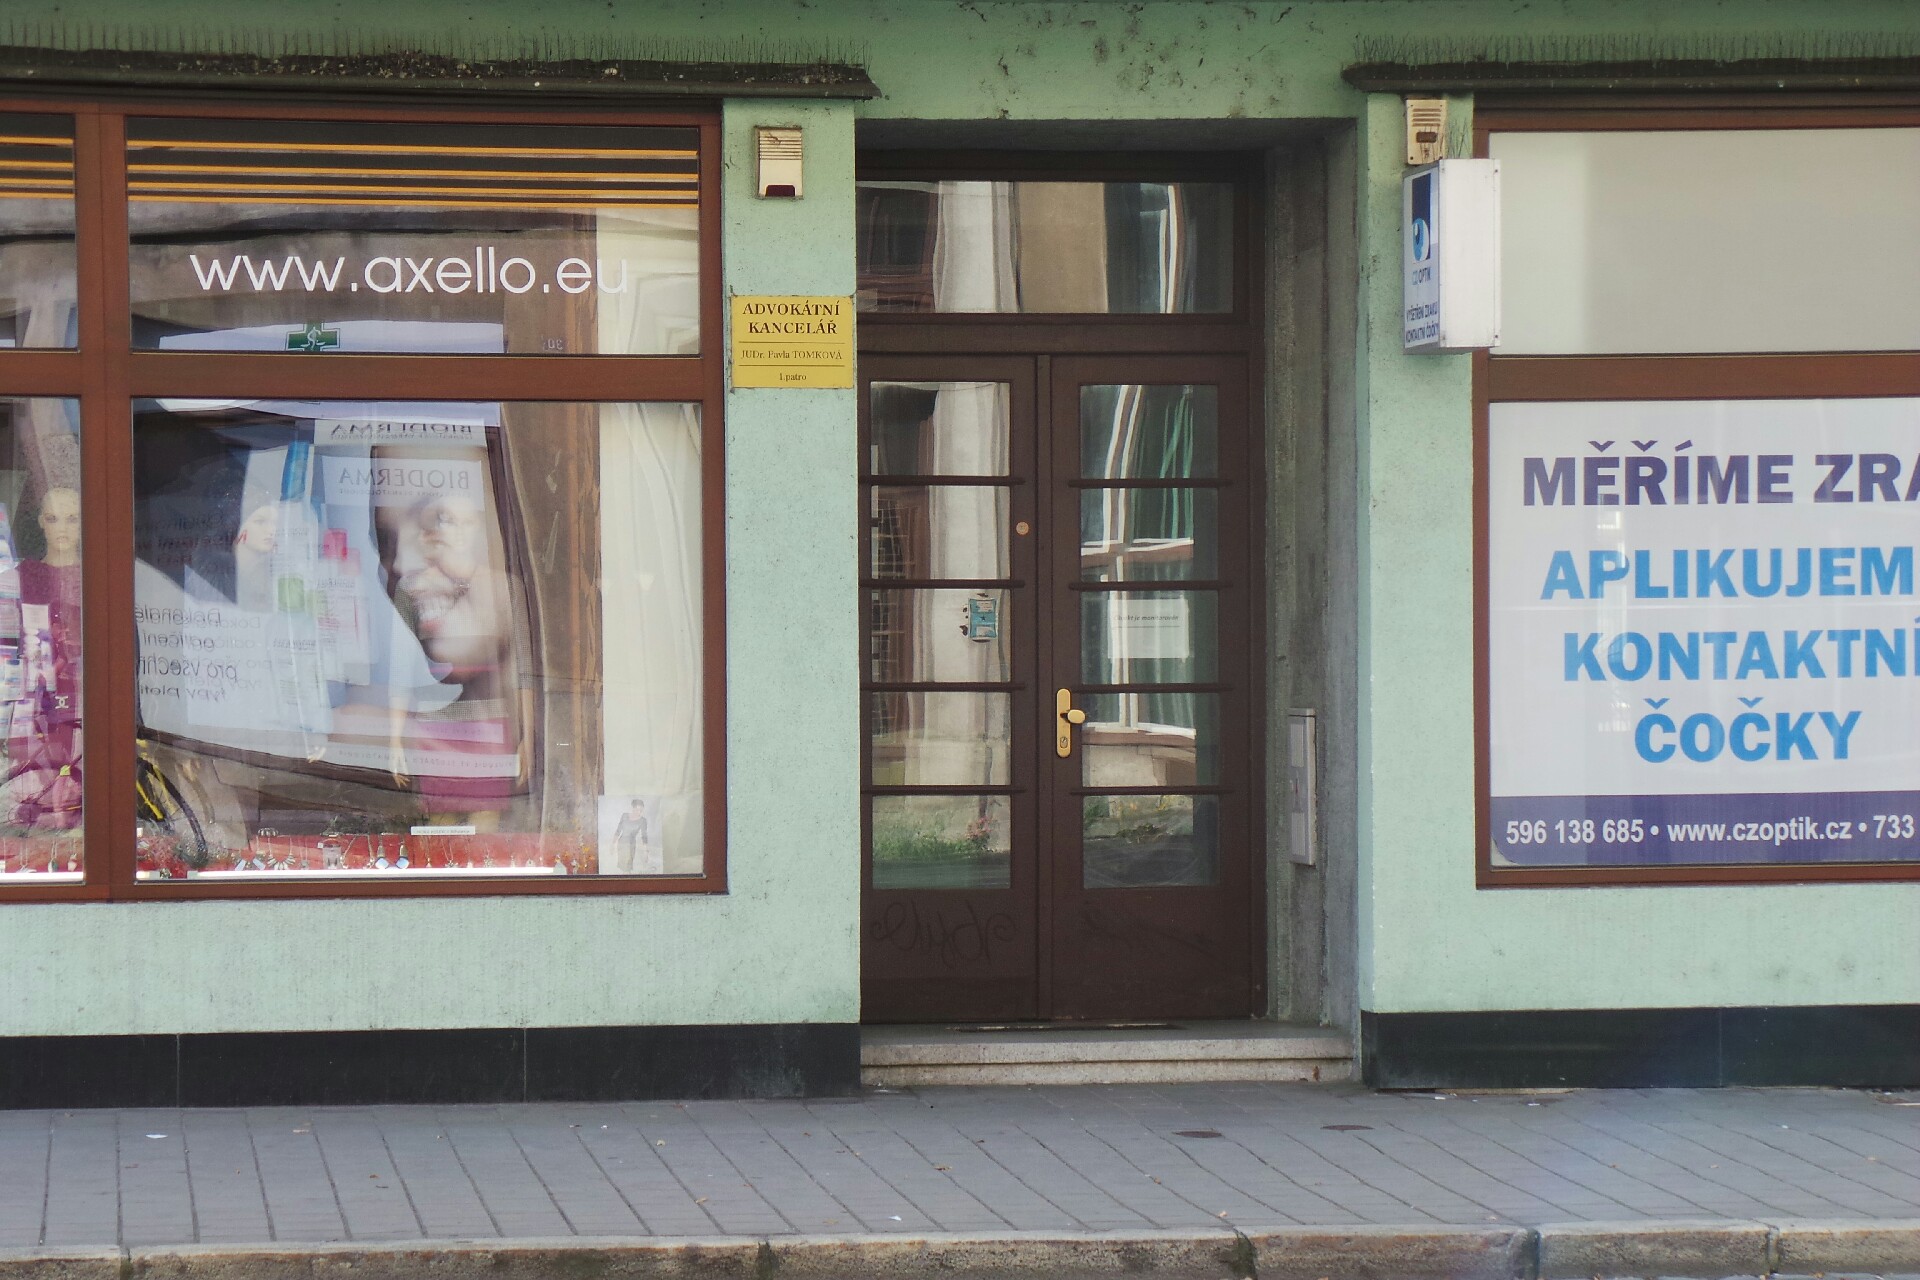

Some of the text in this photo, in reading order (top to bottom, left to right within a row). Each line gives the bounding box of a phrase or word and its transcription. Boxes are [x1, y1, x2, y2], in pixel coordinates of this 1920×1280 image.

[190, 246, 628, 295] www.axello.eu
[742, 300, 840, 316] ADVOKÁTNÍ
[749, 319, 838, 335] KANCELÁŘ
[740, 349, 843, 360] JUDr. Pavla TOMKOVÁ
[778, 372, 807, 382] 1.patro
[1522, 440, 1794, 507] MĚŘÍME
[1540, 546, 1914, 601] APLIKUJEM
[1634, 696, 1862, 763] ČOČKY
[1506, 814, 1915, 846] 596 138 685 www.czoptik.cz 733
